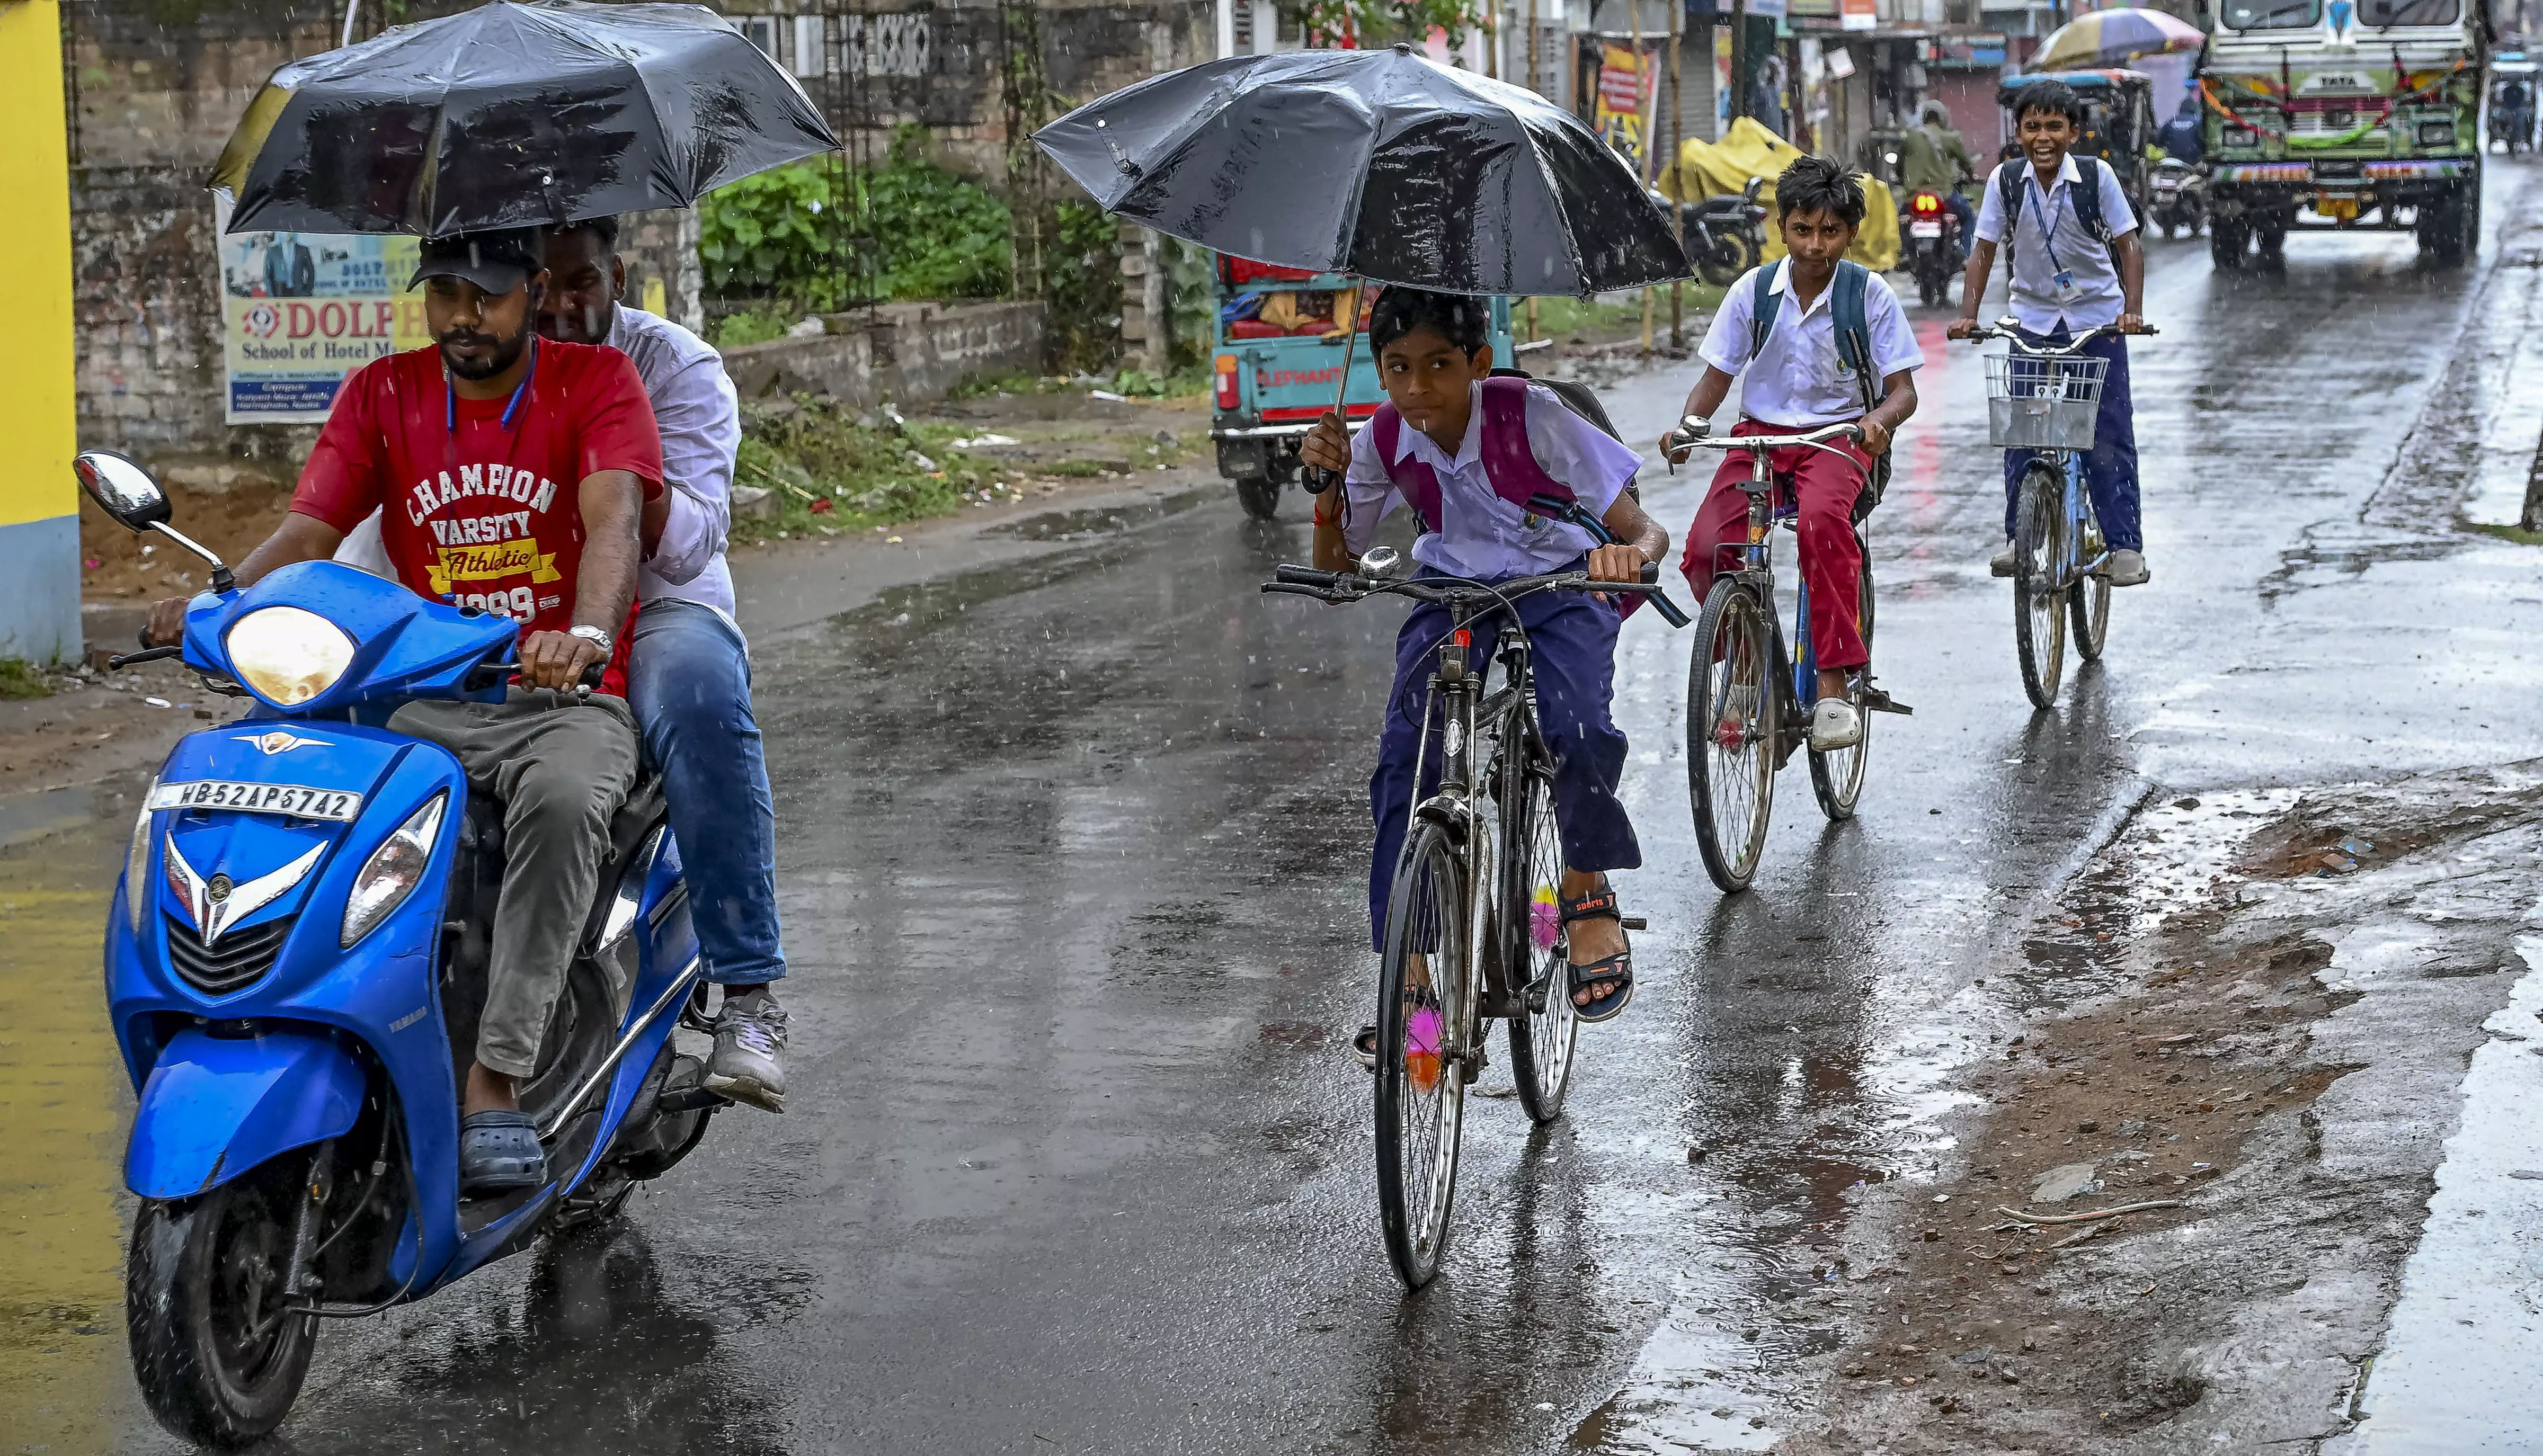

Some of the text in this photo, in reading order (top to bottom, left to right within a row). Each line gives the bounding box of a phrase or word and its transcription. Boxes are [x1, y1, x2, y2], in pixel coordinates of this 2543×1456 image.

[2322, 76, 2356, 86] TATA
[242, 342, 295, 360] School
[300, 341, 317, 360] of
[324, 342, 369, 360] Hotel
[1257, 367, 1343, 387] ELEPHANT
[406, 463, 558, 527] CHAMPION
[430, 511, 530, 545] VARSITY
[446, 549, 534, 575] Athletic
[1576, 899, 1604, 911] sports
